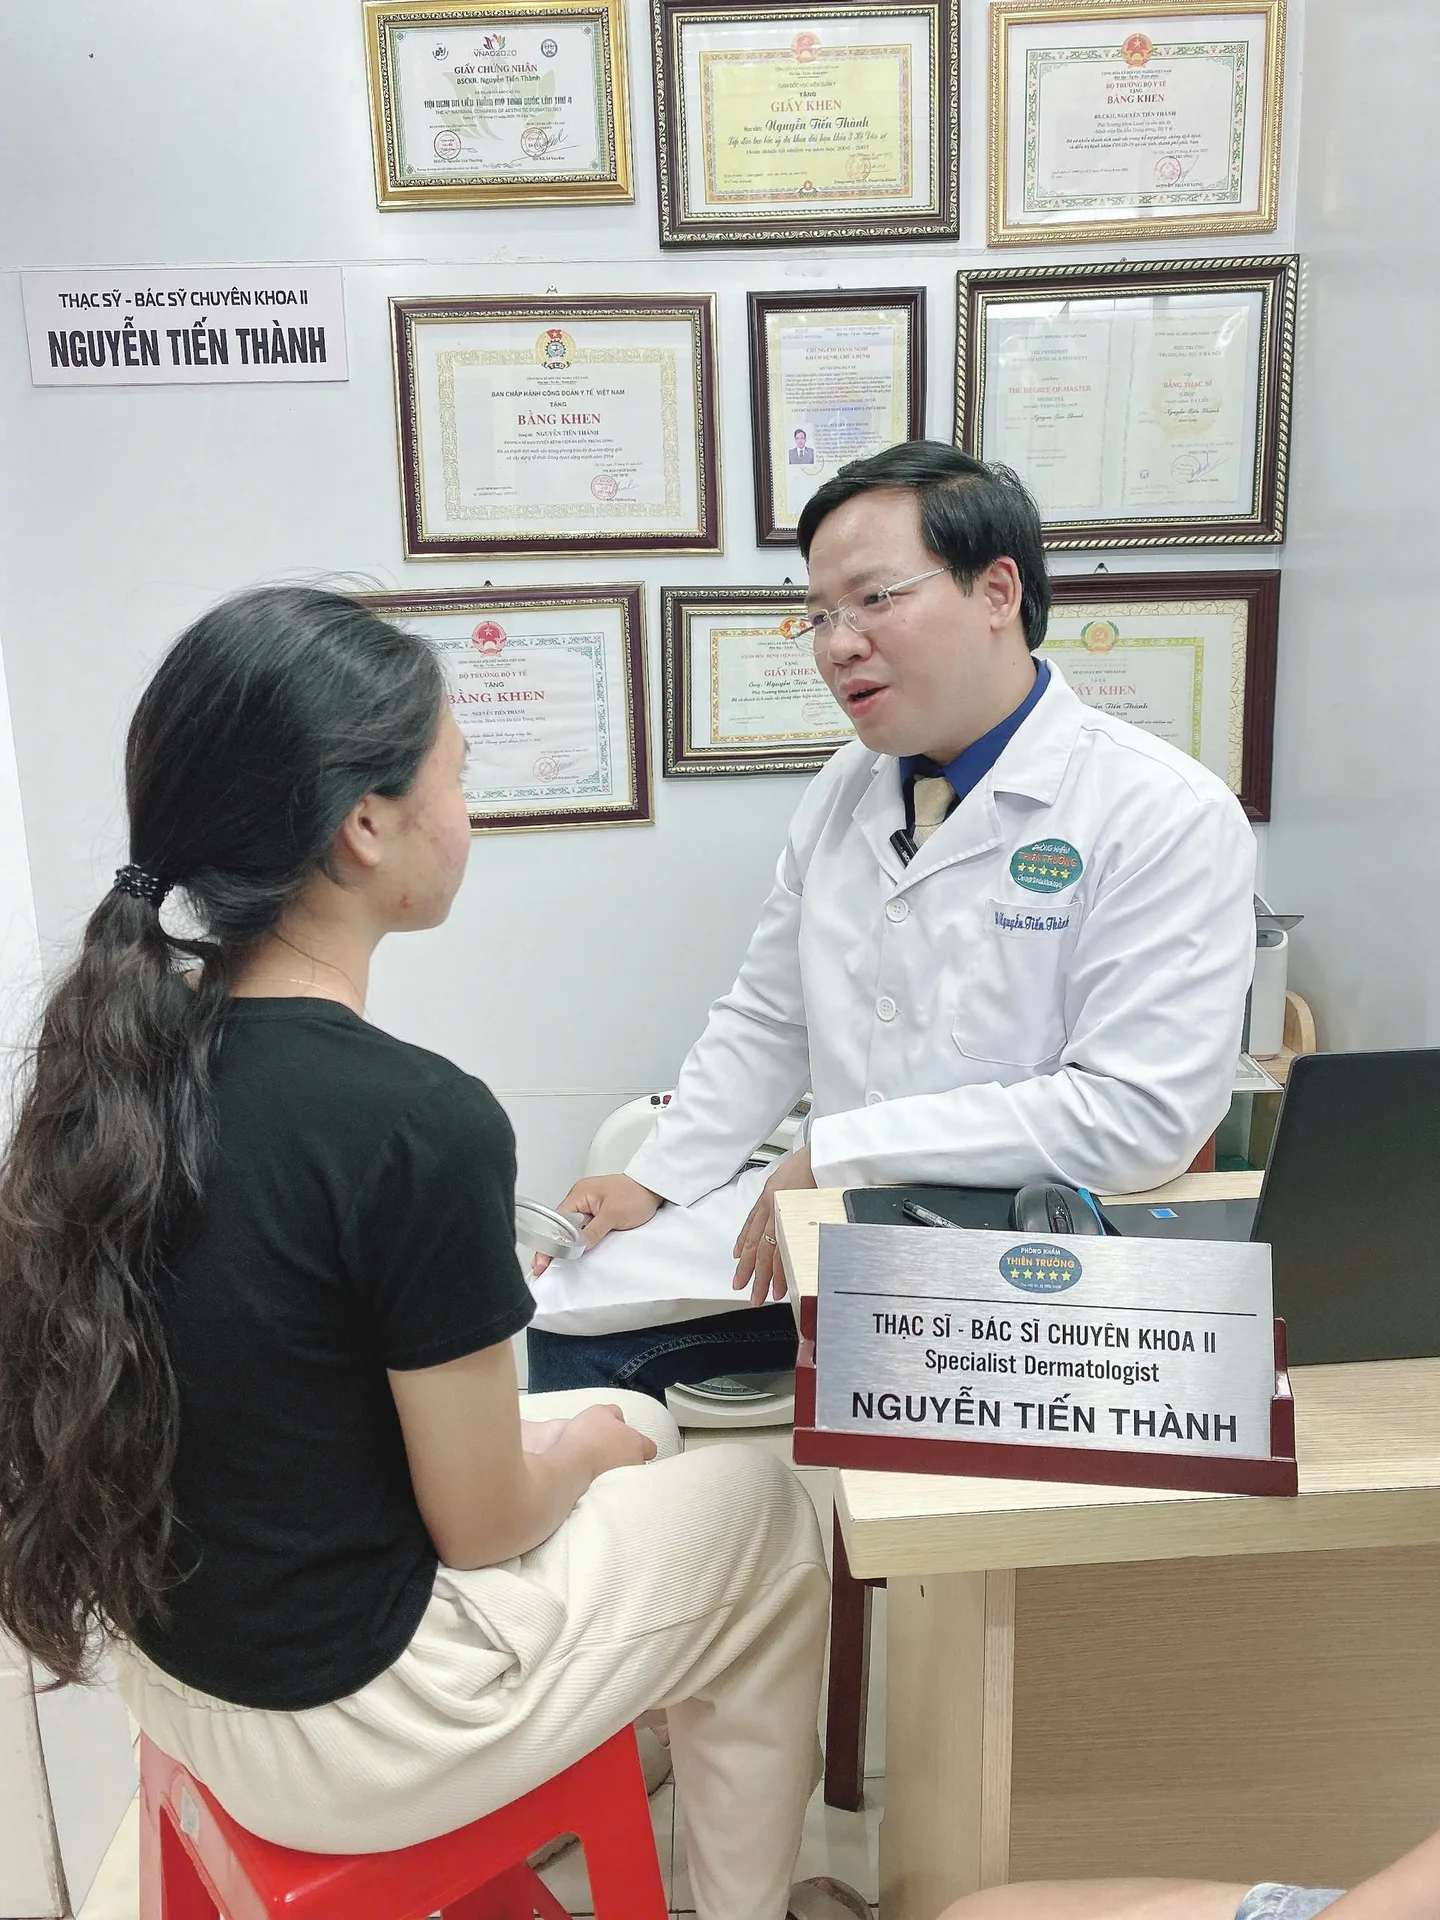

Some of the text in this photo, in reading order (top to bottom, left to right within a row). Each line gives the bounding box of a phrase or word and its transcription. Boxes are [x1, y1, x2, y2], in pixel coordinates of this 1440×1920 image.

[454, 62, 538, 74] GIẤY CHỨNG NHẬN
[770, 97, 841, 112] GIẤY KHEN
[1107, 94, 1164, 104] BẰNG KHEN
[765, 116, 869, 133] Nguyễn Tiến Thành
[58, 293, 100, 310] THẠC
[103, 290, 122, 307] SỸ
[135, 288, 166, 307] BÁC
[168, 289, 187, 307] SỸ
[190, 287, 251, 306] CHUYÊN
[254, 290, 296, 305] KHOA
[299, 290, 308, 305] II
[48, 316, 327, 367] NGUYỄN TIẾN THÀNH
[518, 410, 600, 426] BẰNG KHEN
[764, 666, 787, 677] GIẤY
[497, 691, 545, 702] KHEN
[1099, 685, 1136, 695] KHEN
[995, 911, 1070, 930] Nguyễn Tiến Thành
[1020, 1246, 1042, 1254] PHÒNG
[1006, 1256, 1075, 1268] THIÊN TRƯỜNG
[873, 1313, 923, 1340] THẠC
[933, 1313, 951, 1338] SĨ
[971, 1315, 1011, 1342] BÁC
[1020, 1318, 1039, 1343] SĨ
[1048, 1321, 1128, 1348] CHUYÊN
[1139, 1329, 1195, 1352] KHOA
[1204, 1332, 1216, 1353] II
[925, 1350, 1160, 1384] Specialist Dermatologist
[852, 1386, 1237, 1442] NGUYỄN TIẾN THÀNH
